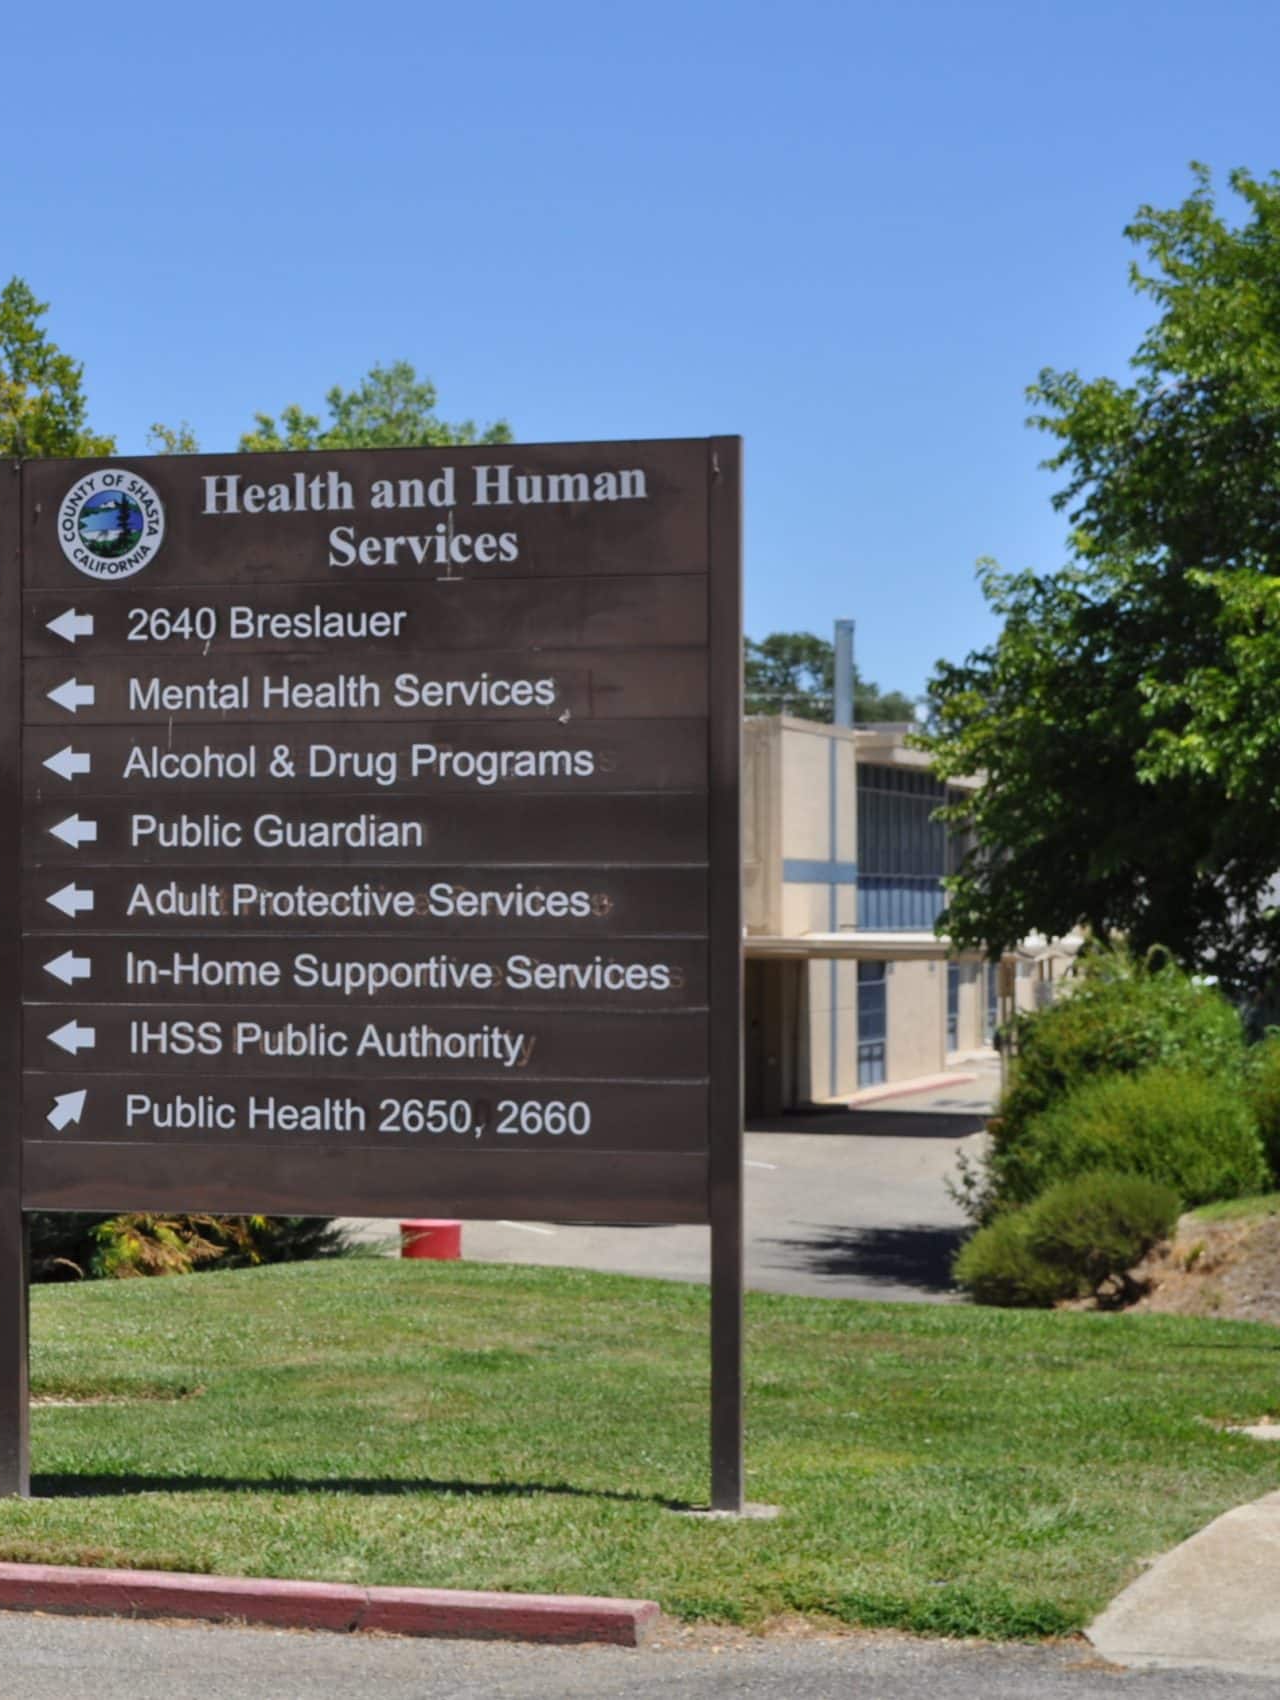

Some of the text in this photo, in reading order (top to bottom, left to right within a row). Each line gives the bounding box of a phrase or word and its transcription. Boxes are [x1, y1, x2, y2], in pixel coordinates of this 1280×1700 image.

[62, 473, 160, 542] COUNTY OF SHASTA
[201, 465, 646, 514] Health and Human
[73, 544, 151, 574] CALIFORNIA
[329, 523, 518, 567] Services
[127, 605, 407, 641] 2640 Breslauer
[129, 673, 556, 710] Mental Health Services
[122, 743, 595, 786] Alcohol & Drug Programs
[132, 813, 422, 848] Public Guardian
[126, 881, 591, 917] Adult Protective Services
[126, 951, 671, 996] In-Home Supportive Services
[131, 1021, 524, 1067] IHSS Public Authority
[126, 1094, 591, 1138] Public Health 2650, 2660
